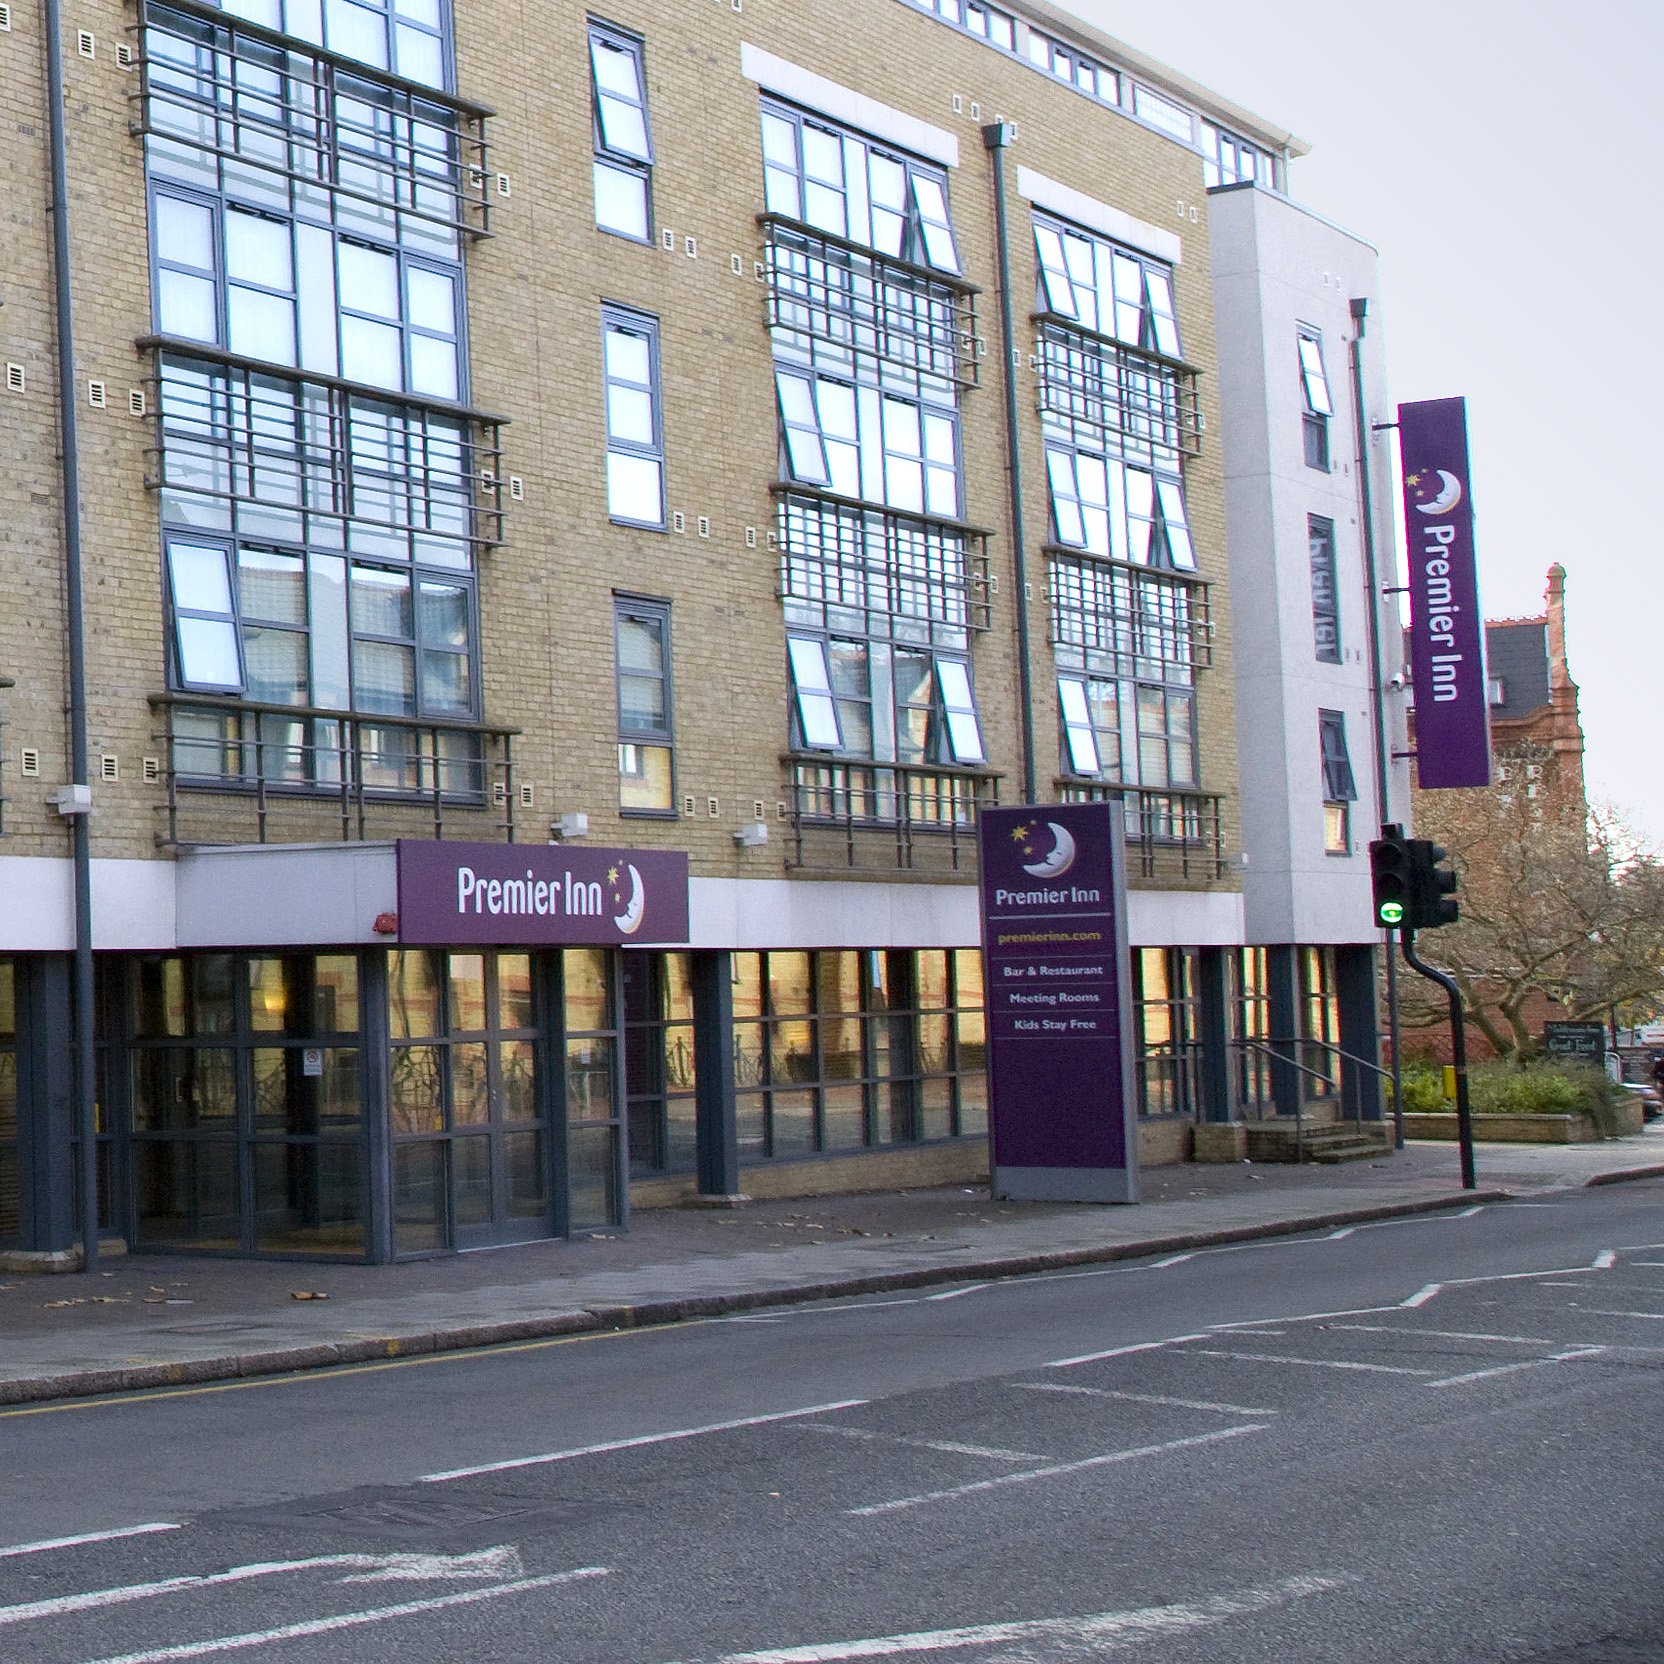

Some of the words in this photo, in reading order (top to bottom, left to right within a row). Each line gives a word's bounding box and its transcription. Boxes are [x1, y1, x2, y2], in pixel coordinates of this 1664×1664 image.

[1424, 525, 1459, 647] Premier
[1432, 654, 1462, 702] Inn
[458, 867, 561, 915] Premier
[565, 870, 603, 916] Inn
[995, 888, 1068, 905] Premier
[1071, 886, 1100, 903] Inn
[998, 930, 1102, 945] premierinn.com
[1003, 966, 1024, 976] Bar
[1027, 966, 1036, 976] &
[1039, 965, 1104, 976] Restaurant
[1009, 993, 1056, 1006] Meeting
[1059, 992, 1099, 1003] Rooms
[1014, 1020, 1039, 1030] Kids
[1042, 1019, 1067, 1031] Stay
[1070, 1019, 1097, 1029] Free
